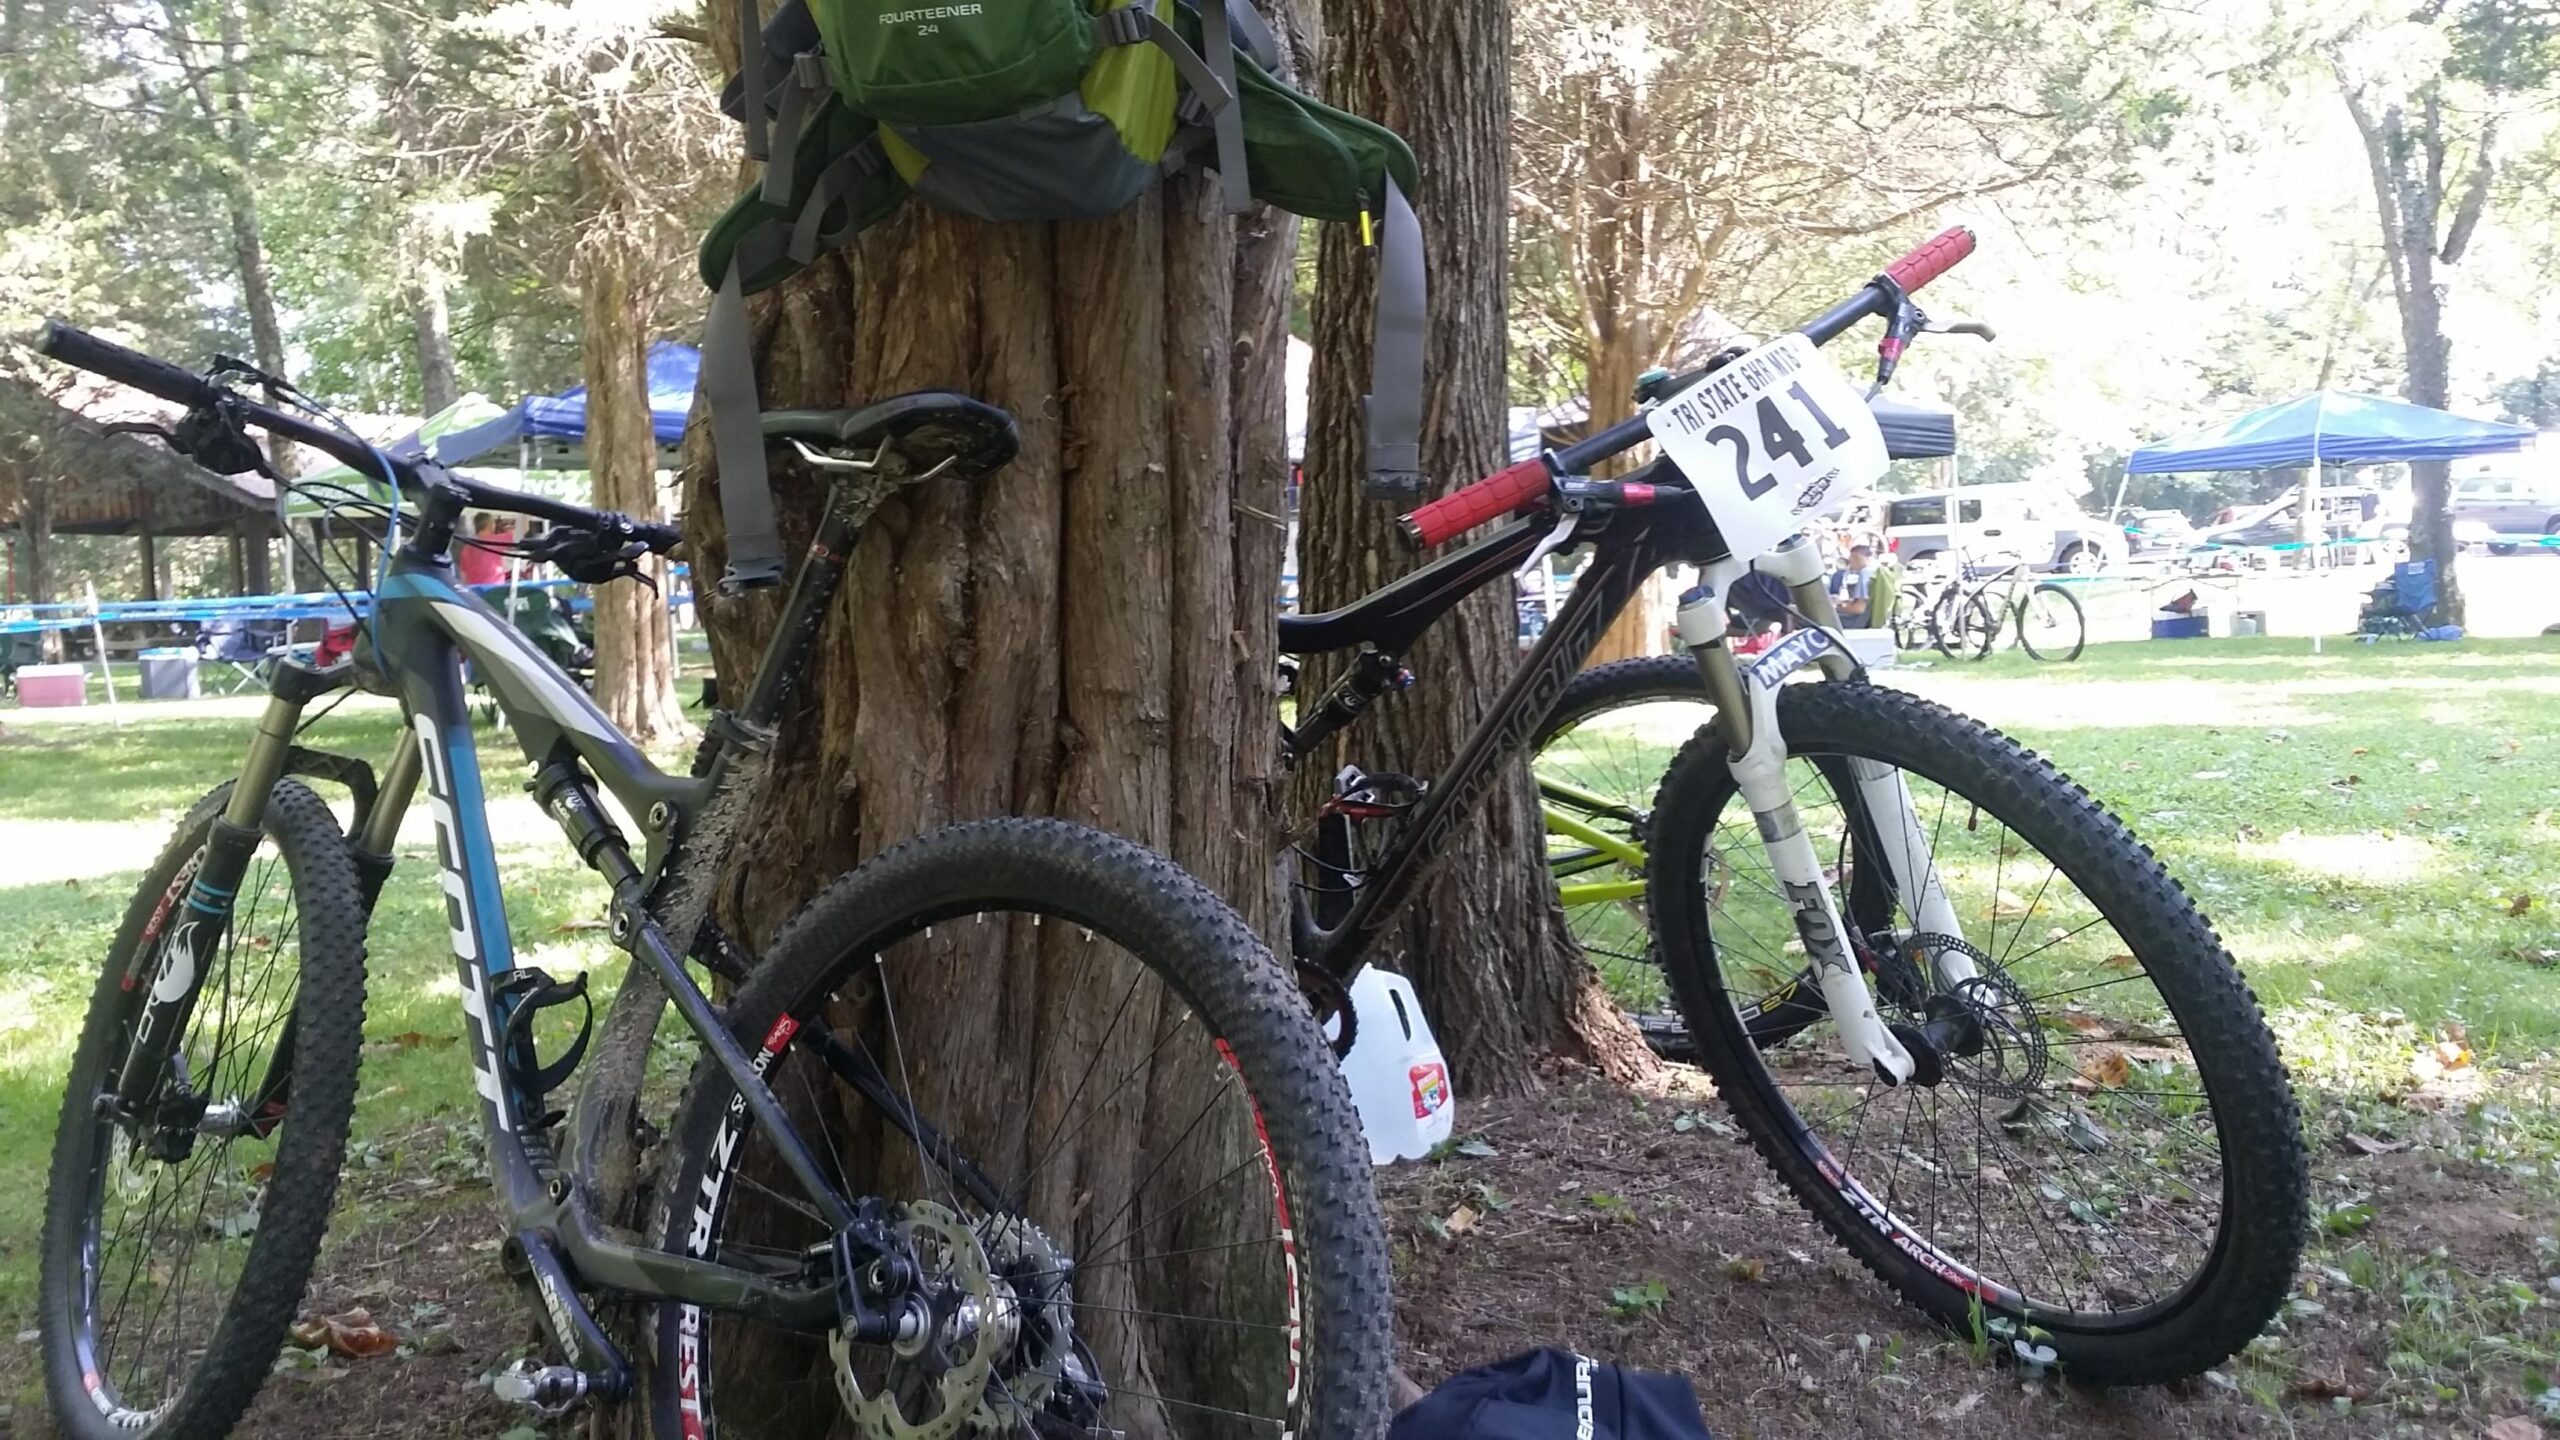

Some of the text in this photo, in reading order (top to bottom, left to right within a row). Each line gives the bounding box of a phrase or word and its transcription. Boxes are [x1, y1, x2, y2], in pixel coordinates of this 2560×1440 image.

[879, 3, 982, 24] FOURTEENER
[918, 24, 939, 36] 24
[1671, 399, 1705, 435] TRI
[1697, 373, 1748, 420] STATE
[1740, 358, 1776, 391] 6HR
[1705, 380, 1851, 501] 241
[415, 712, 512, 1130] SCOTT
[1783, 880, 1854, 976] FOX
[688, 1115, 739, 1258] ZTR
[1840, 1187, 1893, 1236] ZTR
[1893, 1237, 1947, 1276] ARCH
[537, 1274, 581, 1364] SRAM
[678, 1303, 703, 1425] REST
